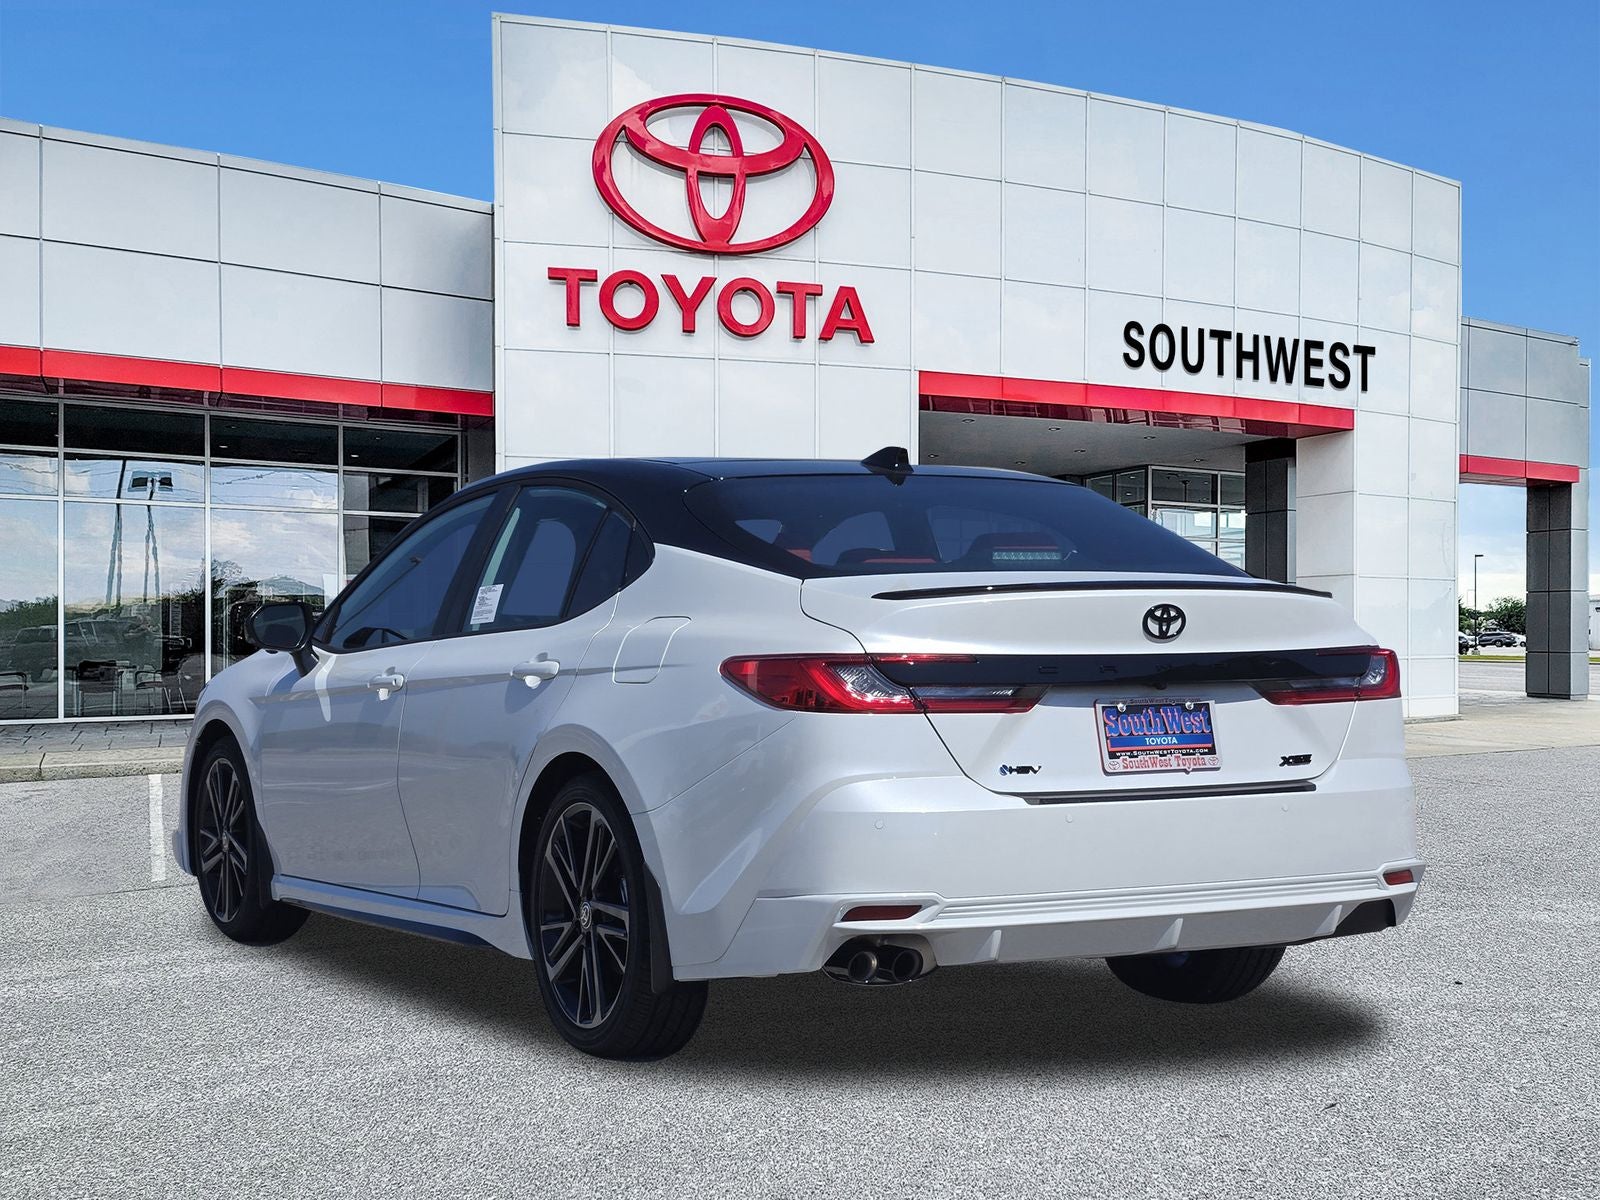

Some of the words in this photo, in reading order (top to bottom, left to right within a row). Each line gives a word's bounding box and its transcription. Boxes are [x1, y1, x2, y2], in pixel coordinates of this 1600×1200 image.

[547, 266, 875, 344] TOYOTA
[1122, 320, 1376, 393] SOUTHWEST
[1103, 706, 1212, 737] SouthWest
[1145, 736, 1178, 745] TOYOTA
[1009, 765, 1042, 775] HEV
[1122, 756, 1173, 770] SouthWest
[1174, 753, 1207, 767] Toyota
